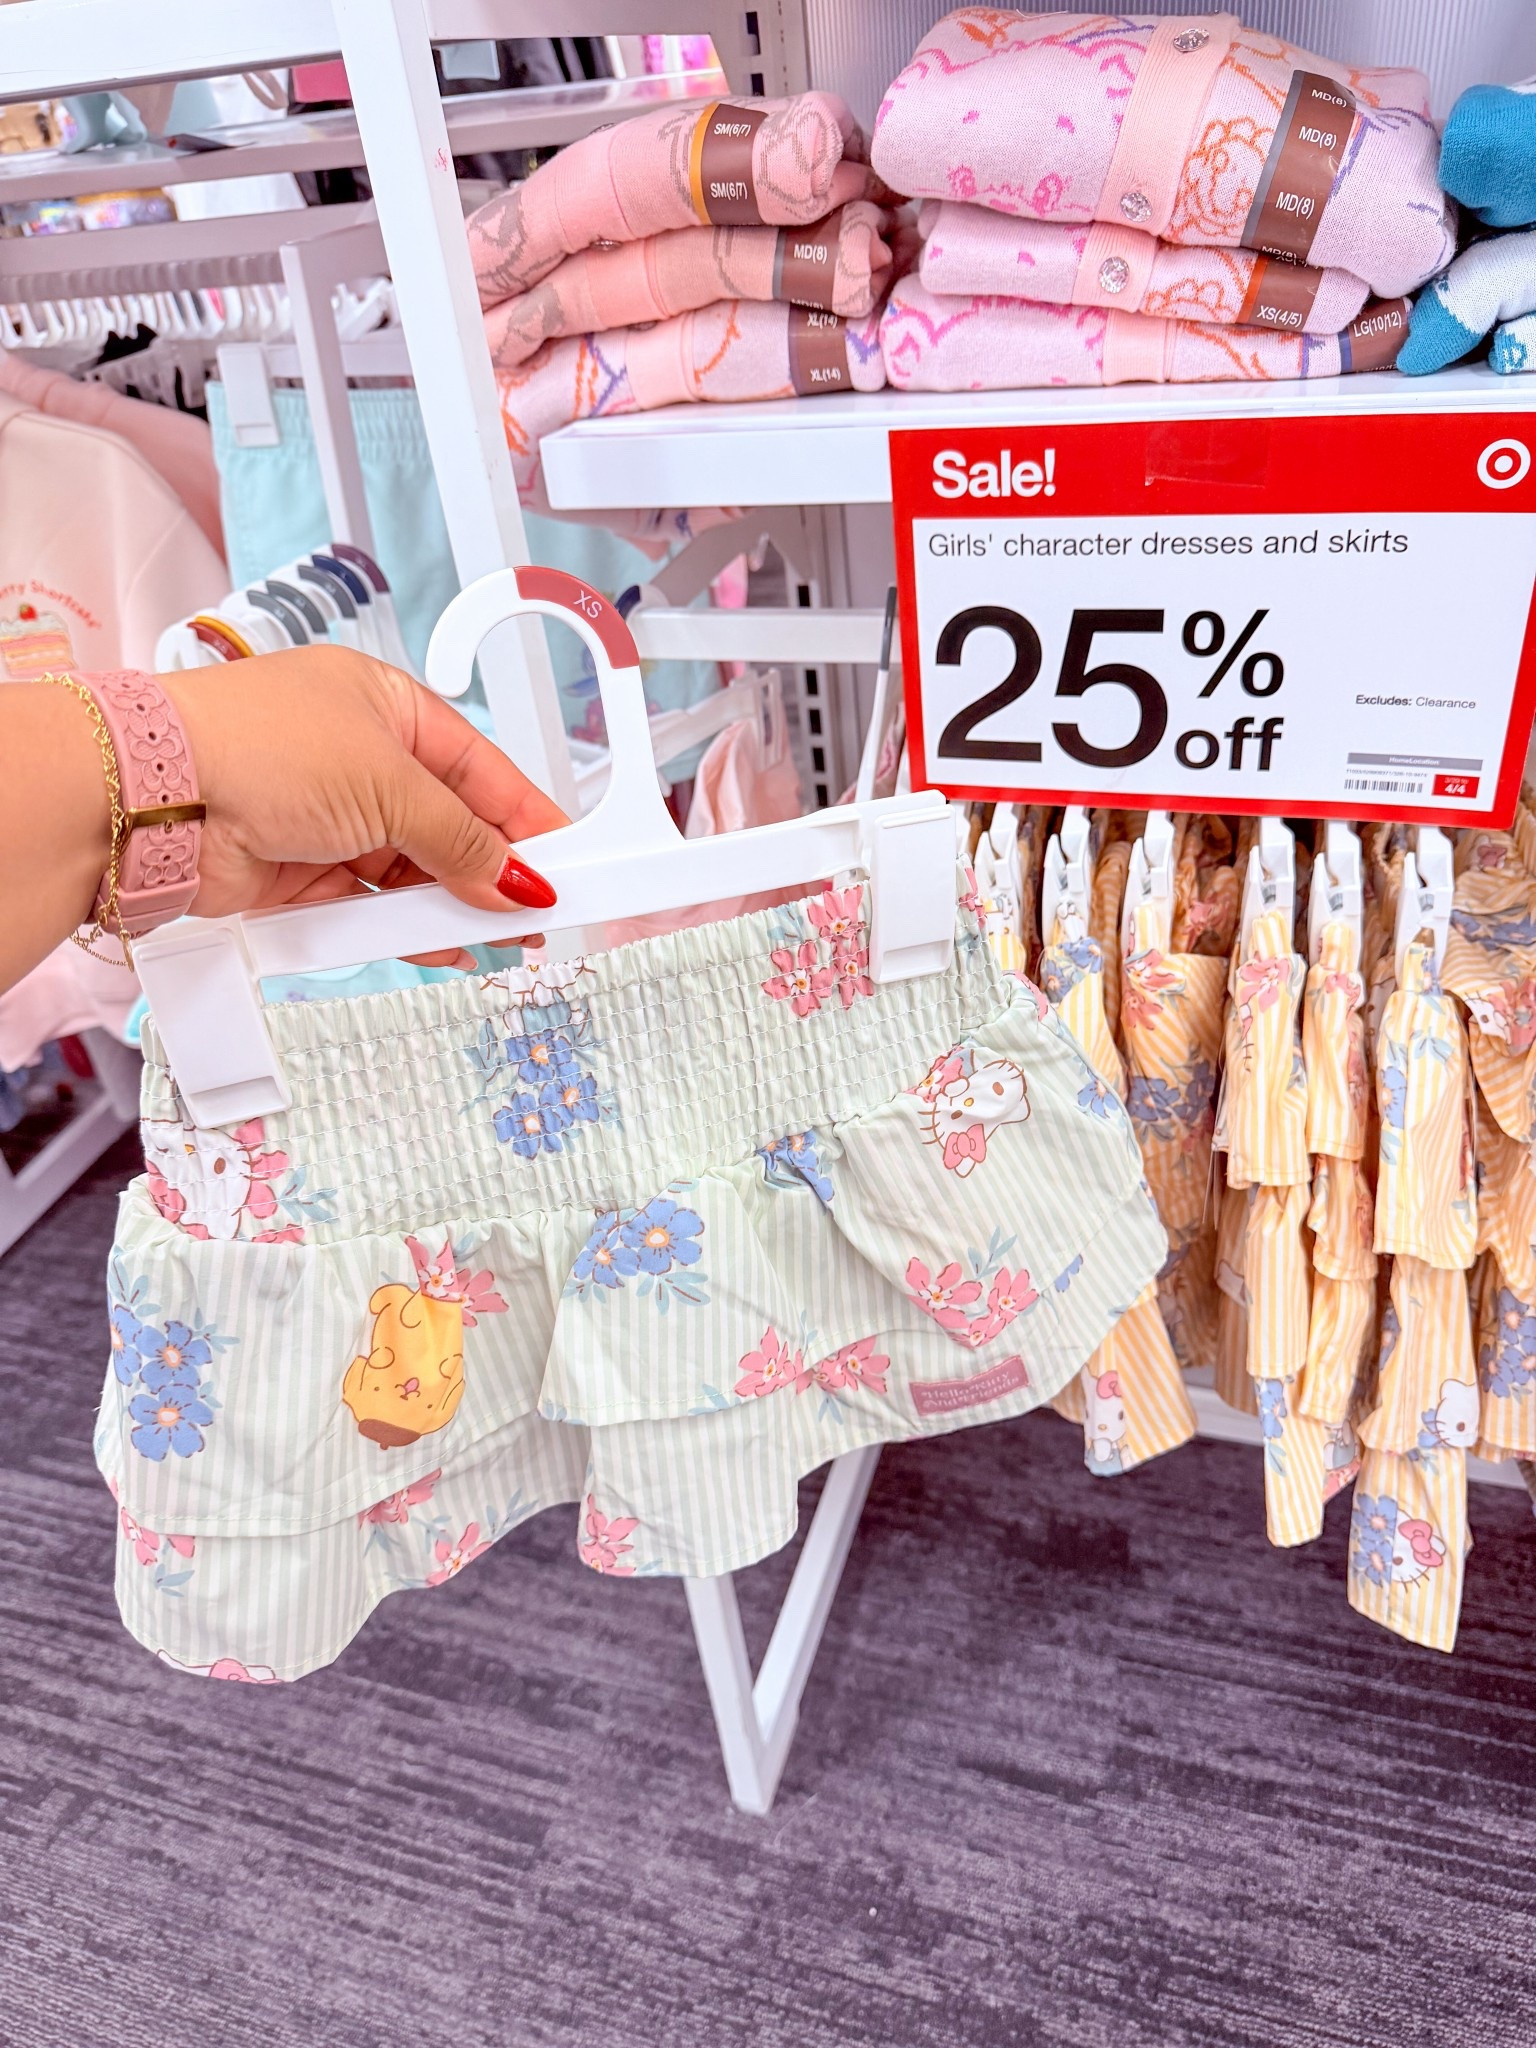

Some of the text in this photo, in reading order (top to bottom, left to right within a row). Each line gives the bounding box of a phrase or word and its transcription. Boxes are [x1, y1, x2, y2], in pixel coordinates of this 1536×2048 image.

[1311, 89, 1347, 108] MD(8)
[714, 123, 751, 137] SM(6/7)
[1298, 126, 1337, 150] MD(8)
[710, 182, 748, 200] SM(6/7)
[1275, 192, 1315, 219] MD(8)
[794, 244, 828, 264] MD(8)
[807, 312, 838, 329] XL(14)
[1257, 305, 1303, 328] XS(4/5)
[1353, 310, 1402, 337] LG(10/12)
[810, 368, 841, 383] XL(14)
[932, 449, 1057, 499] Sale!
[928, 529, 1410, 558] Girls' character dresses and skirts
[573, 589, 603, 619] XS
[1355, 694, 1477, 709] Excludes: Clearance
[1174, 716, 1285, 773] off
[1444, 783, 1466, 795] 4/4
[921, 1371, 1010, 1399] Hello Kitty
[922, 1376, 1020, 1408] And Friends
